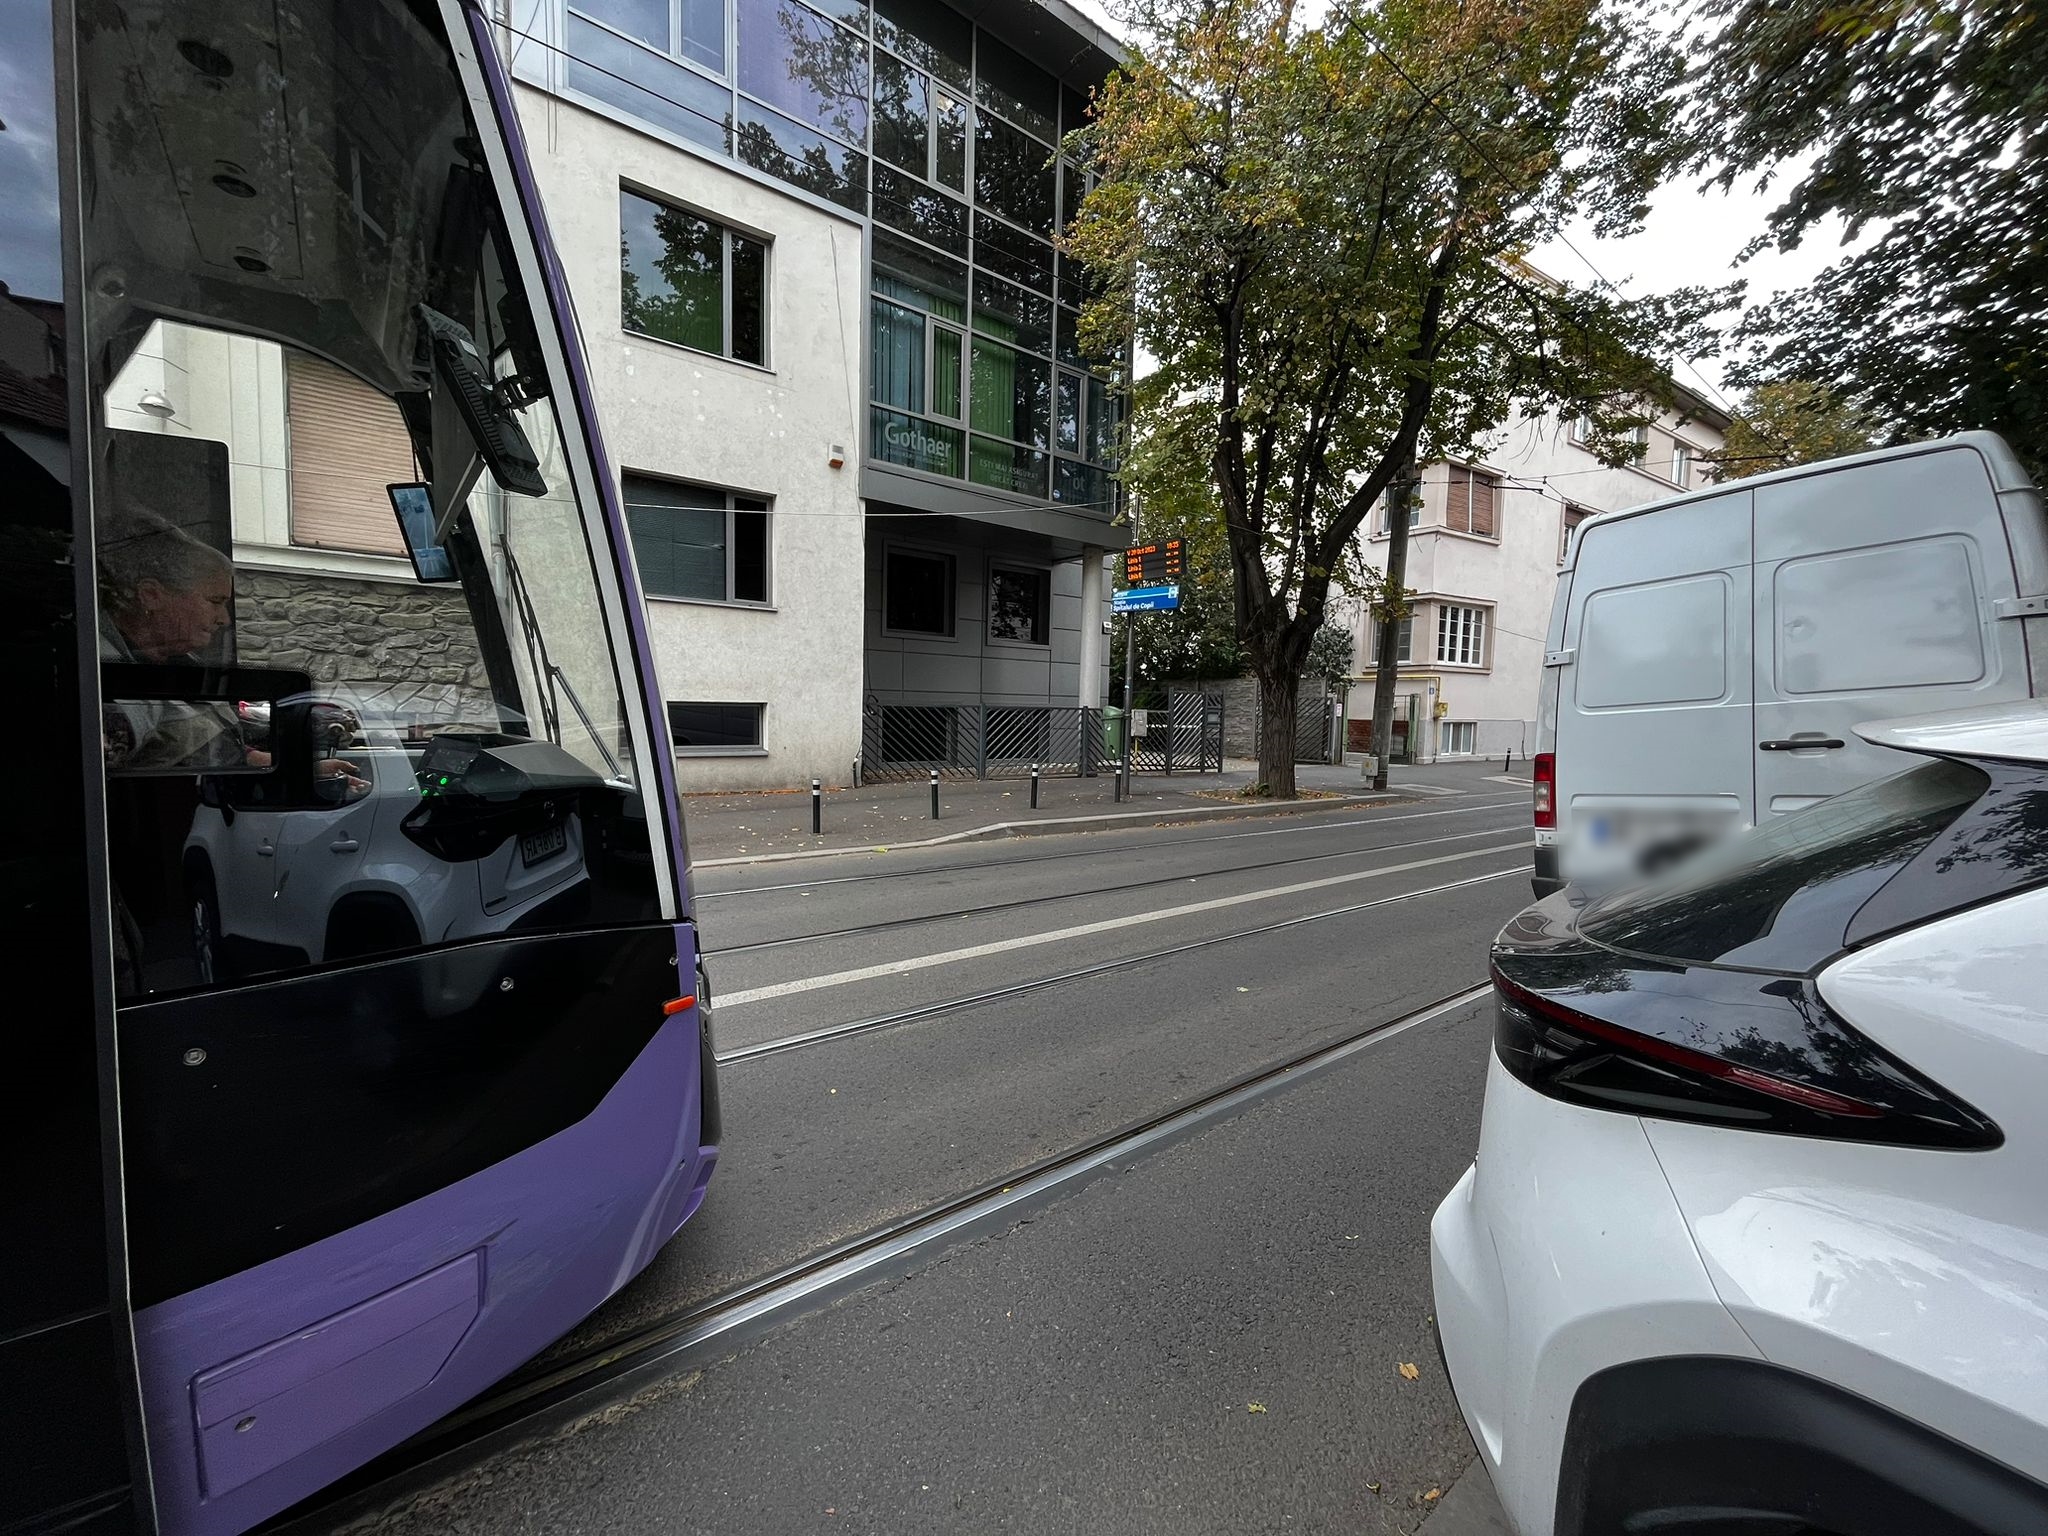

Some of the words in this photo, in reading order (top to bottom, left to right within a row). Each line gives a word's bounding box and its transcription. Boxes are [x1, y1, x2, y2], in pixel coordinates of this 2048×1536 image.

[885, 422, 952, 458] Gothaer
[1113, 603, 1132, 612] Spitalul
[1140, 601, 1154, 610] Copii
